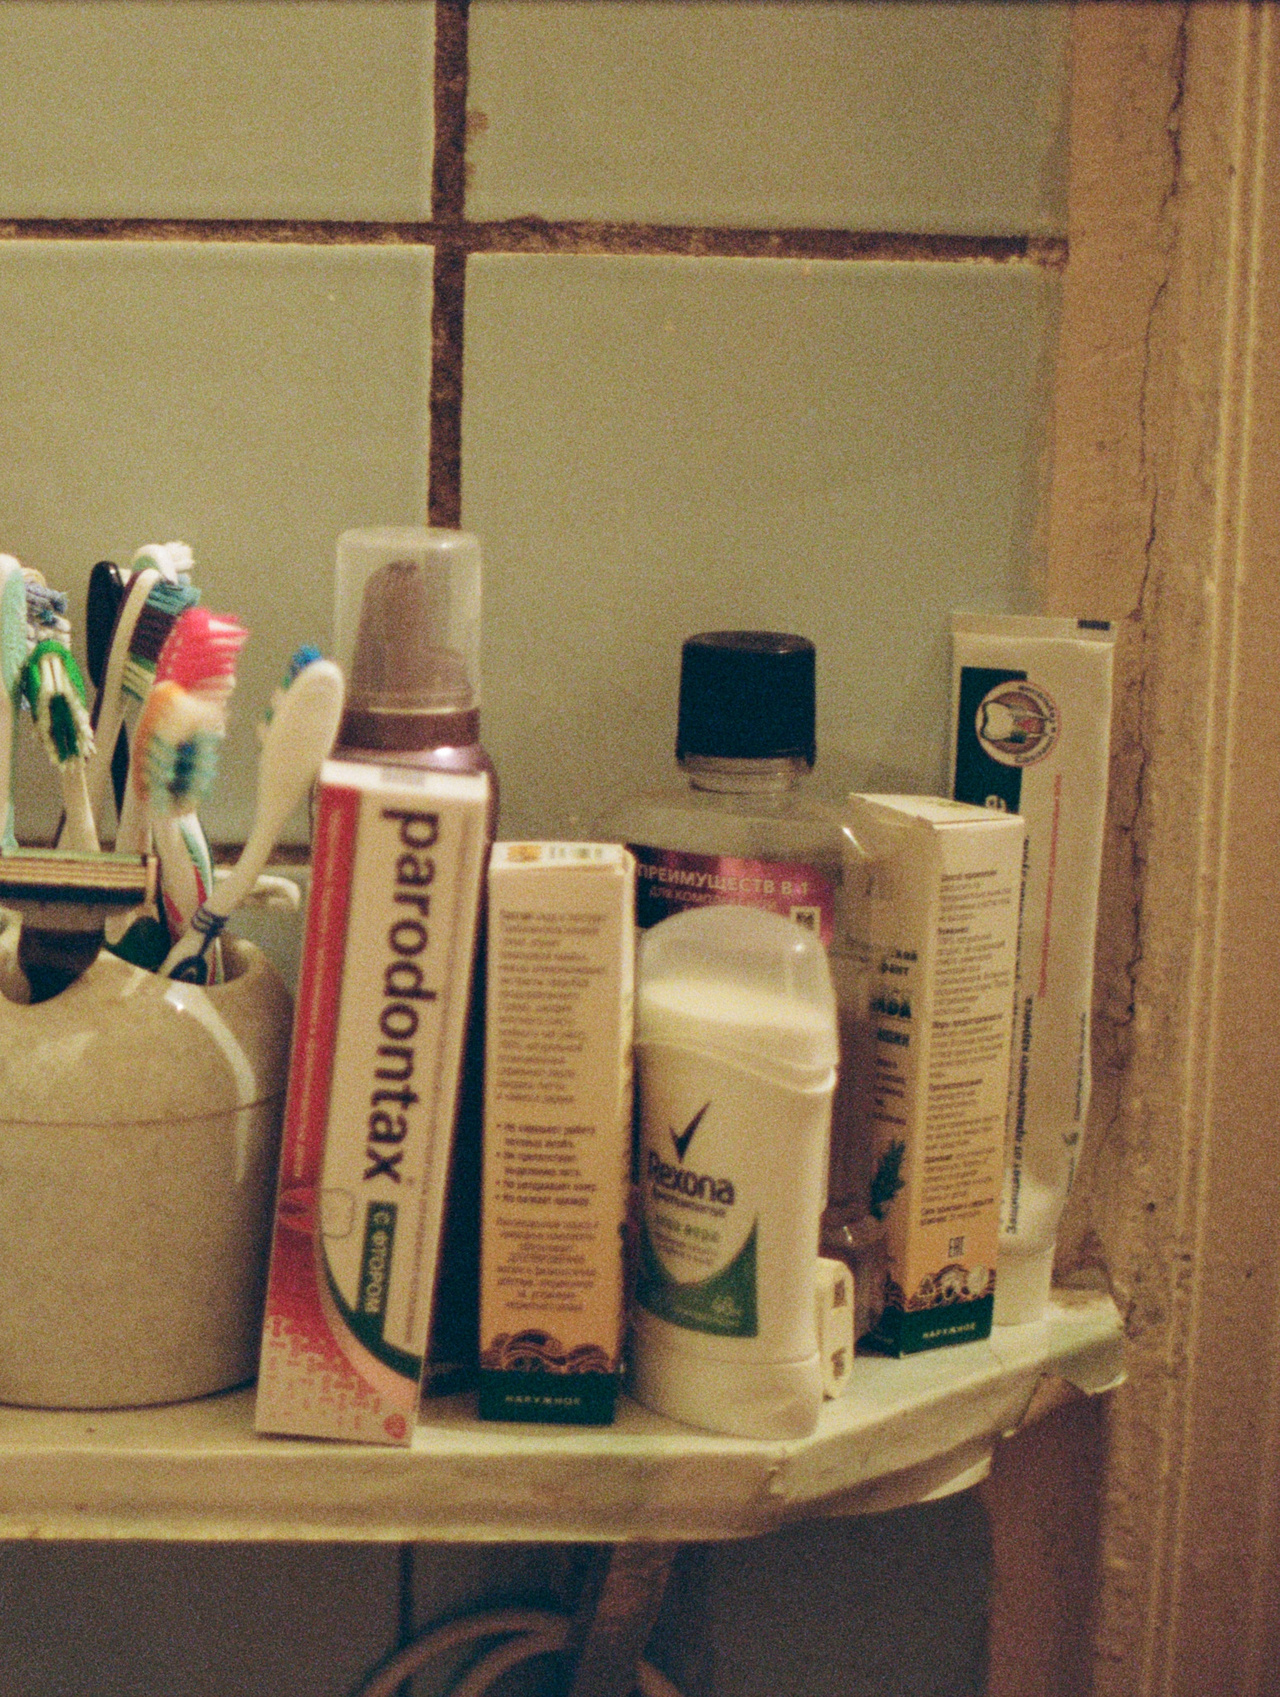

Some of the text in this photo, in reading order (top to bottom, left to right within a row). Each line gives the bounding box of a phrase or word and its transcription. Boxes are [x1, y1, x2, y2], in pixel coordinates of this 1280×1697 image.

[637, 863, 774, 894] ПРЕИМУЩЕСТВ
[363, 807, 440, 1184] parodontax
[648, 1150, 736, 1206] Rexona
[363, 1229, 389, 1316] ФТОРОМ
